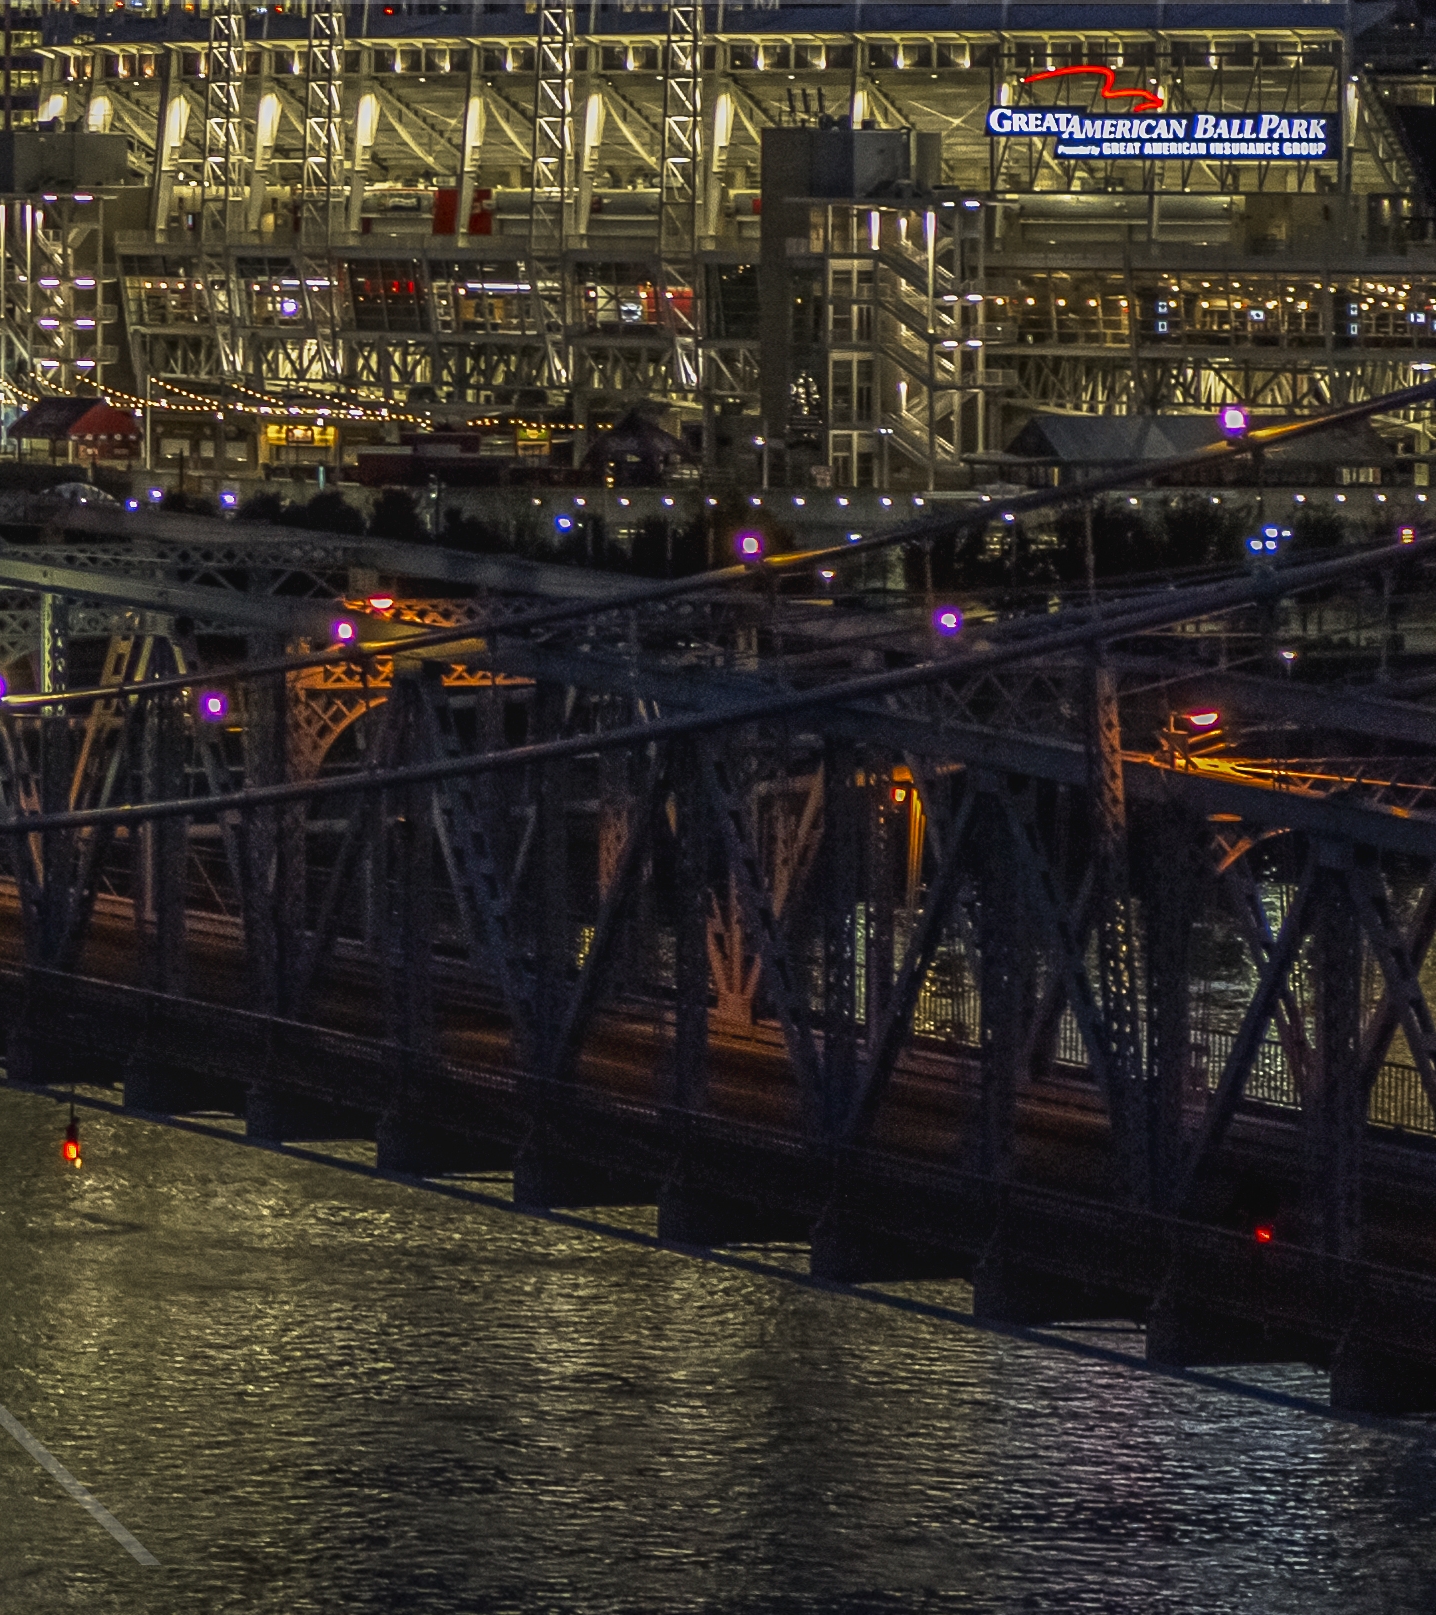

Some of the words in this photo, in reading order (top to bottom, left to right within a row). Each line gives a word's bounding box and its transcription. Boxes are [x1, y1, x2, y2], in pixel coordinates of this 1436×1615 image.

[1102, 142, 1142, 155] GREAT
[1143, 142, 1207, 155] AMERICAN
[1209, 142, 1280, 155] INSURANCE
[1282, 142, 1327, 155] GROUP
